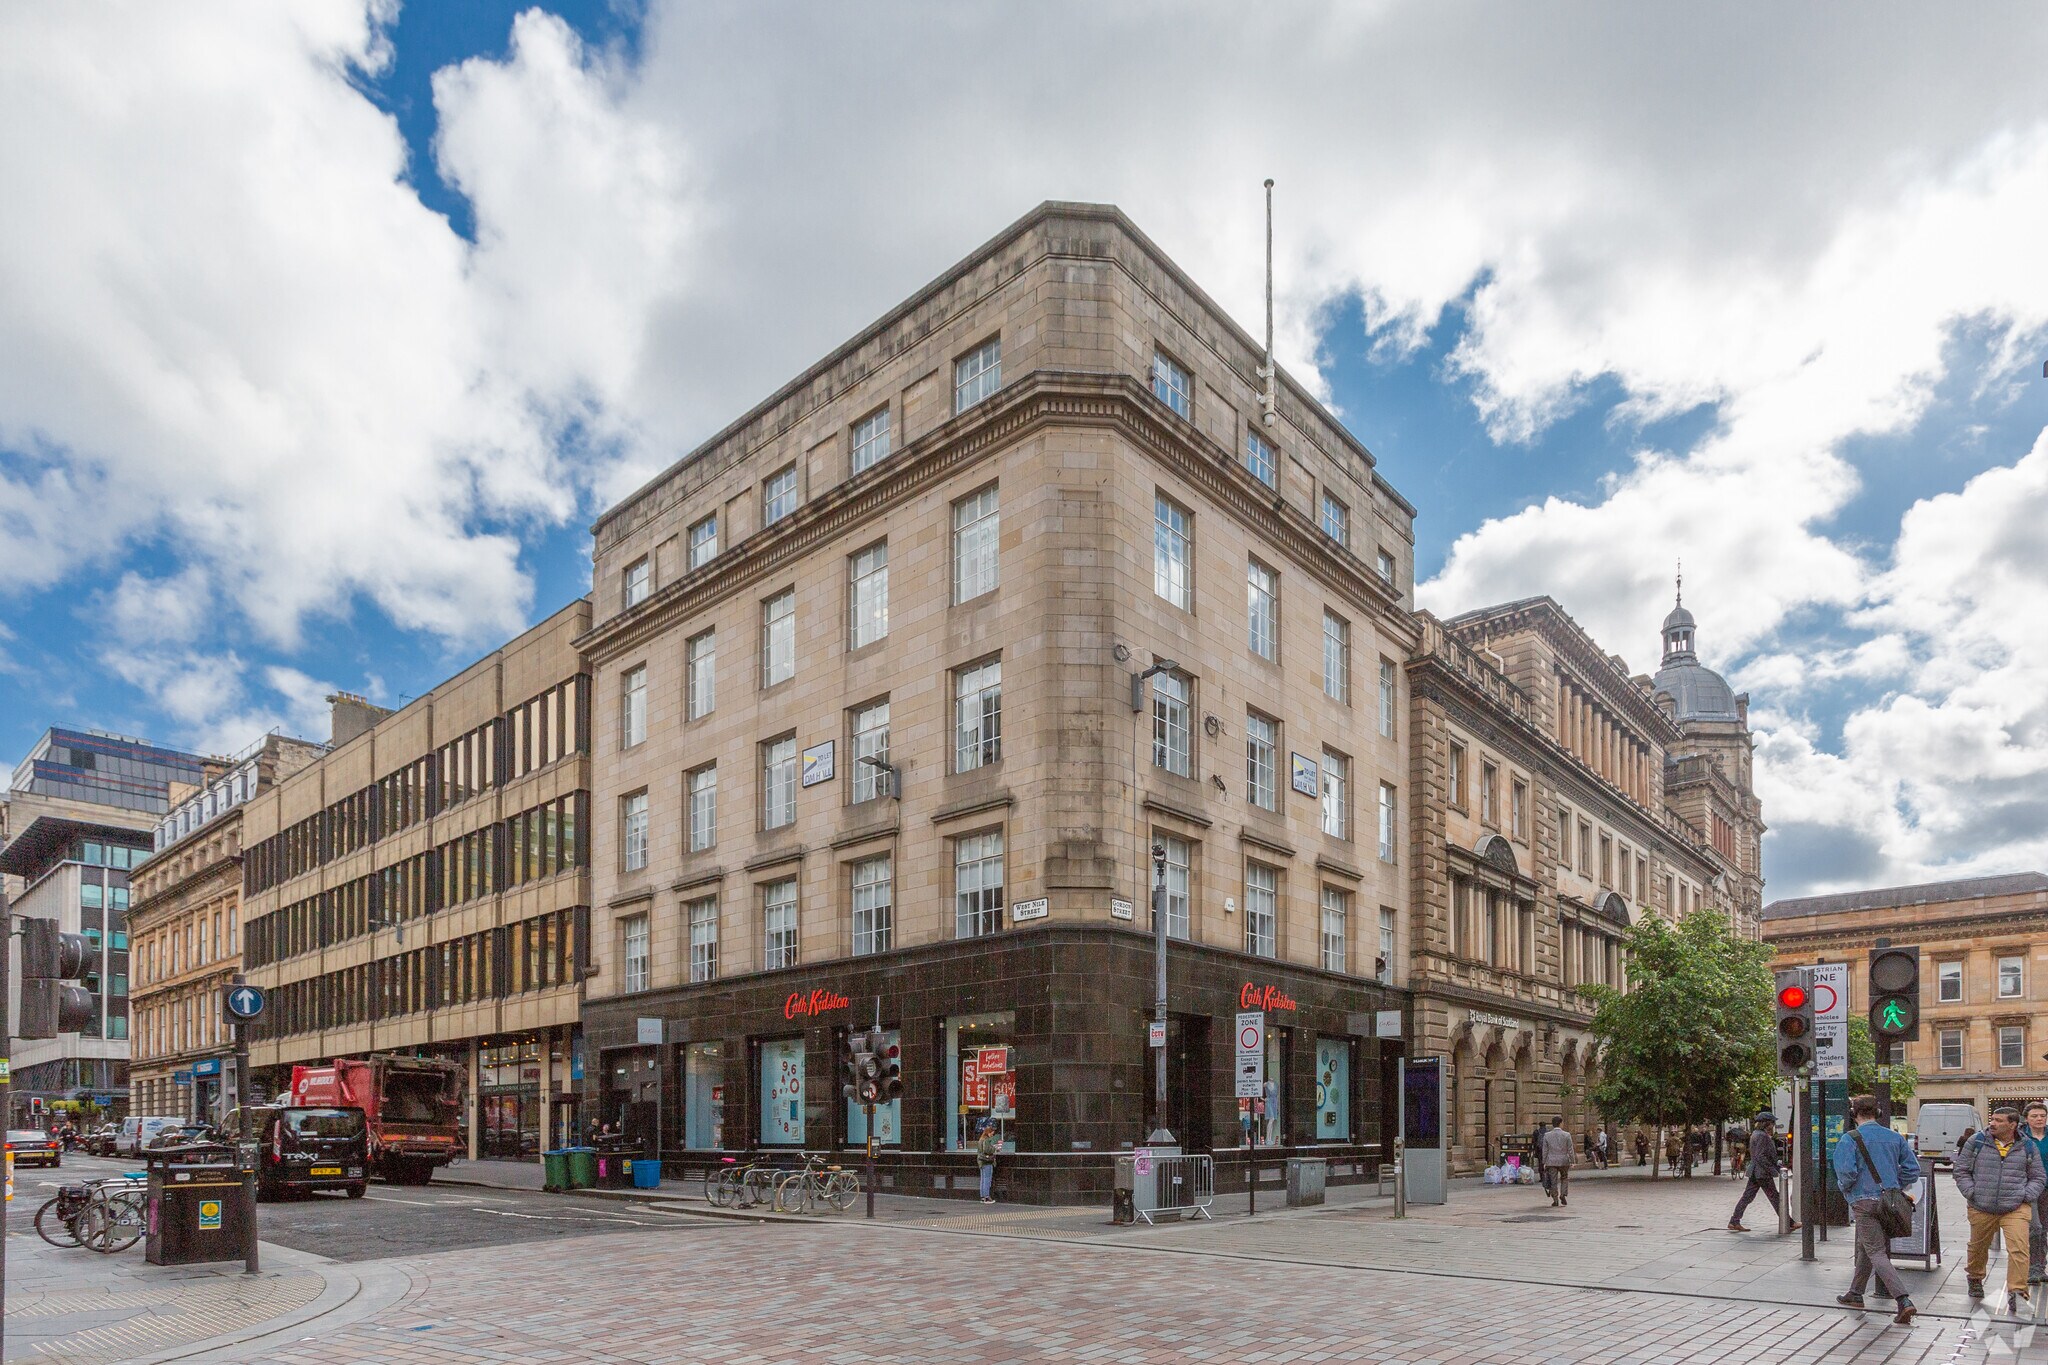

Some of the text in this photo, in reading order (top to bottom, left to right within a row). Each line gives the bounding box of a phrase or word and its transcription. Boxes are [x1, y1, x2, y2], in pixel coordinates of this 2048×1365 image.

[1113, 900, 1131, 909] GORDON
[1020, 908, 1041, 916] STREET
[1113, 906, 1131, 915] STREET
[1814, 974, 1836, 982] ONE
[1241, 982, 1297, 1012] Cath Kidston
[784, 988, 849, 1019] Cath Kidston
[1476, 1011, 1488, 1025] Royal
[1487, 1013, 1498, 1024] Bank
[1502, 1016, 1519, 1028] Scotland
[782, 1061, 788, 1071] 9
[791, 1064, 797, 1075] 6
[772, 1089, 777, 1099] 9
[966, 1084, 987, 1101] LE
[784, 1122, 789, 1132] 8
[282, 1151, 318, 1161] TAXI
